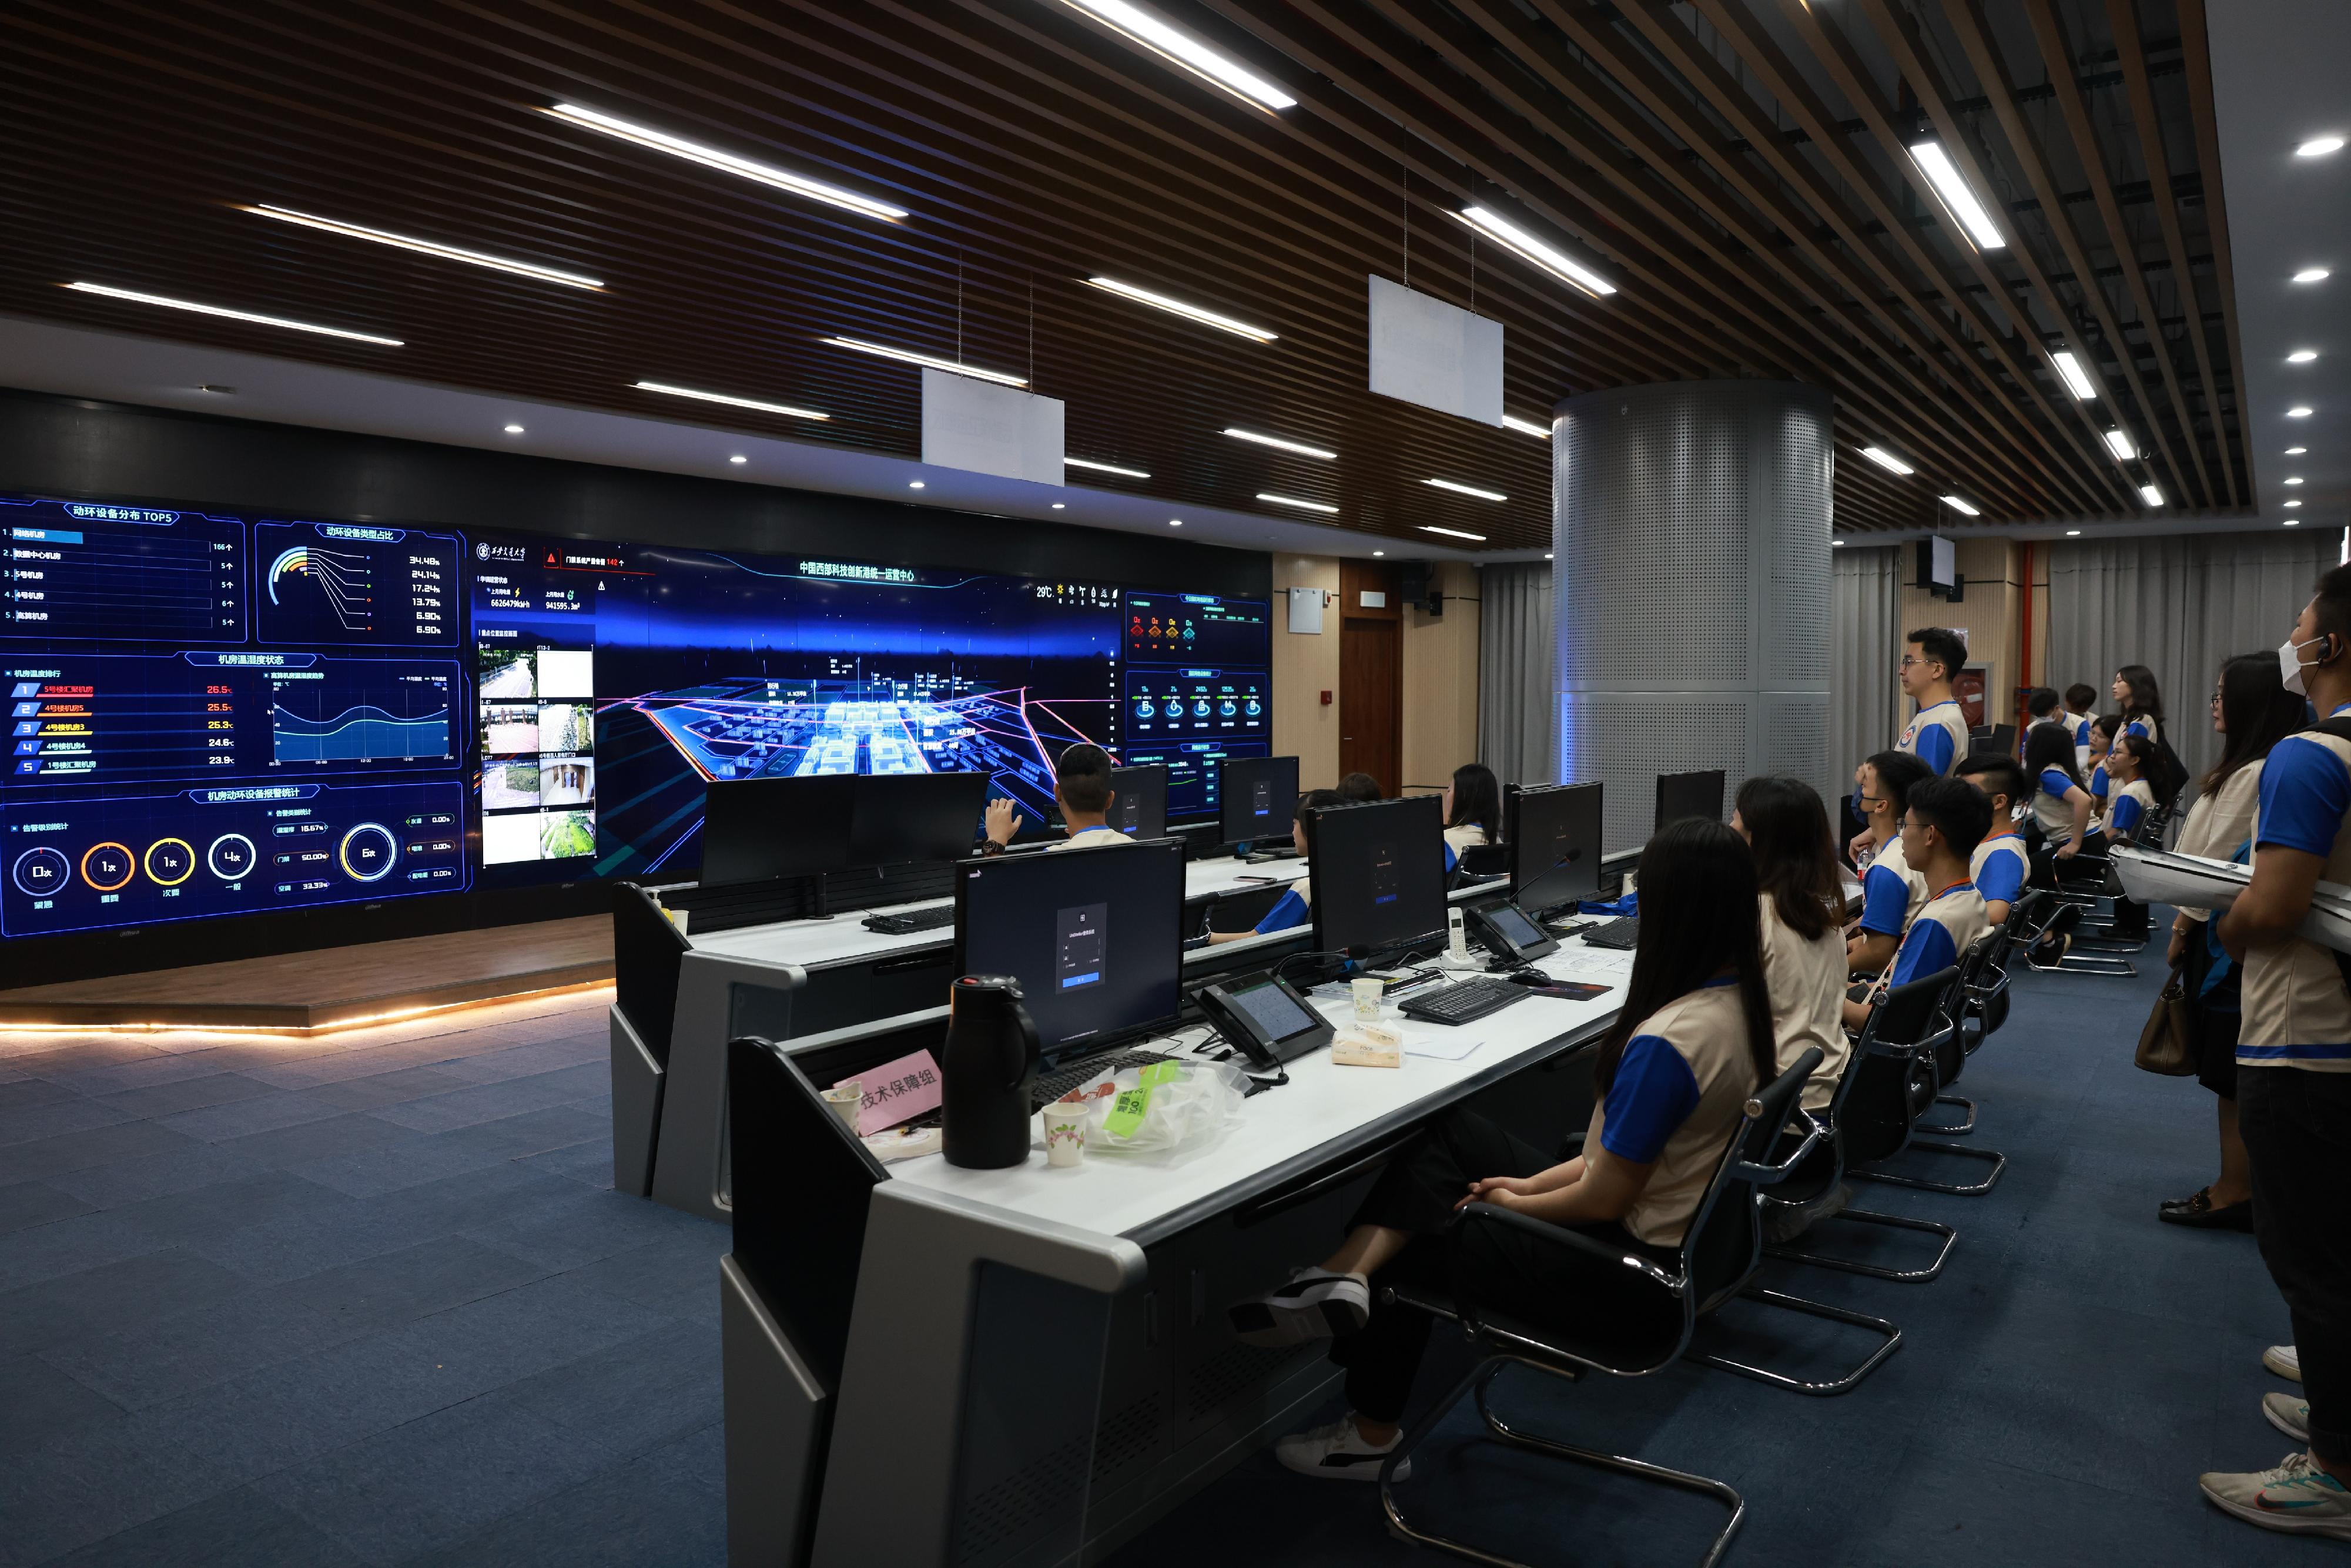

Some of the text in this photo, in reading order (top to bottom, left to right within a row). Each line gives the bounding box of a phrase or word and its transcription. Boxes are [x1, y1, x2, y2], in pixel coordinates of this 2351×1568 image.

[73, 505, 172, 522] 动环设备分布 TOP5
[326, 526, 393, 541] 动环设备类型占比
[14, 550, 61, 559] 数据中心机房
[410, 557, 440, 566] 34.48%
[412, 571, 440, 579] 24.14%
[800, 561, 915, 581] 中国西部科技创新港统一运营中心
[412, 585, 440, 594] 17.24%
[412, 598, 440, 607] 13.79%
[416, 612, 441, 621] 6.90%
[416, 625, 441, 634] 6.90%
[219, 654, 284, 665] 机房温湿度状态
[22, 705, 30, 713] 2
[23, 743, 32, 752] 4
[24, 763, 32, 771] 5
[207, 788, 300, 801] 机房动环设备报警统计
[22, 823, 69, 832] 告警级别统计
[225, 852, 241, 862] 4次
[102, 861, 116, 872] 1次
[164, 857, 177, 867] 1次
[225, 883, 242, 891] 一般
[163, 889, 180, 897] 次要
[860, 1069, 937, 1110] 技术保障组
